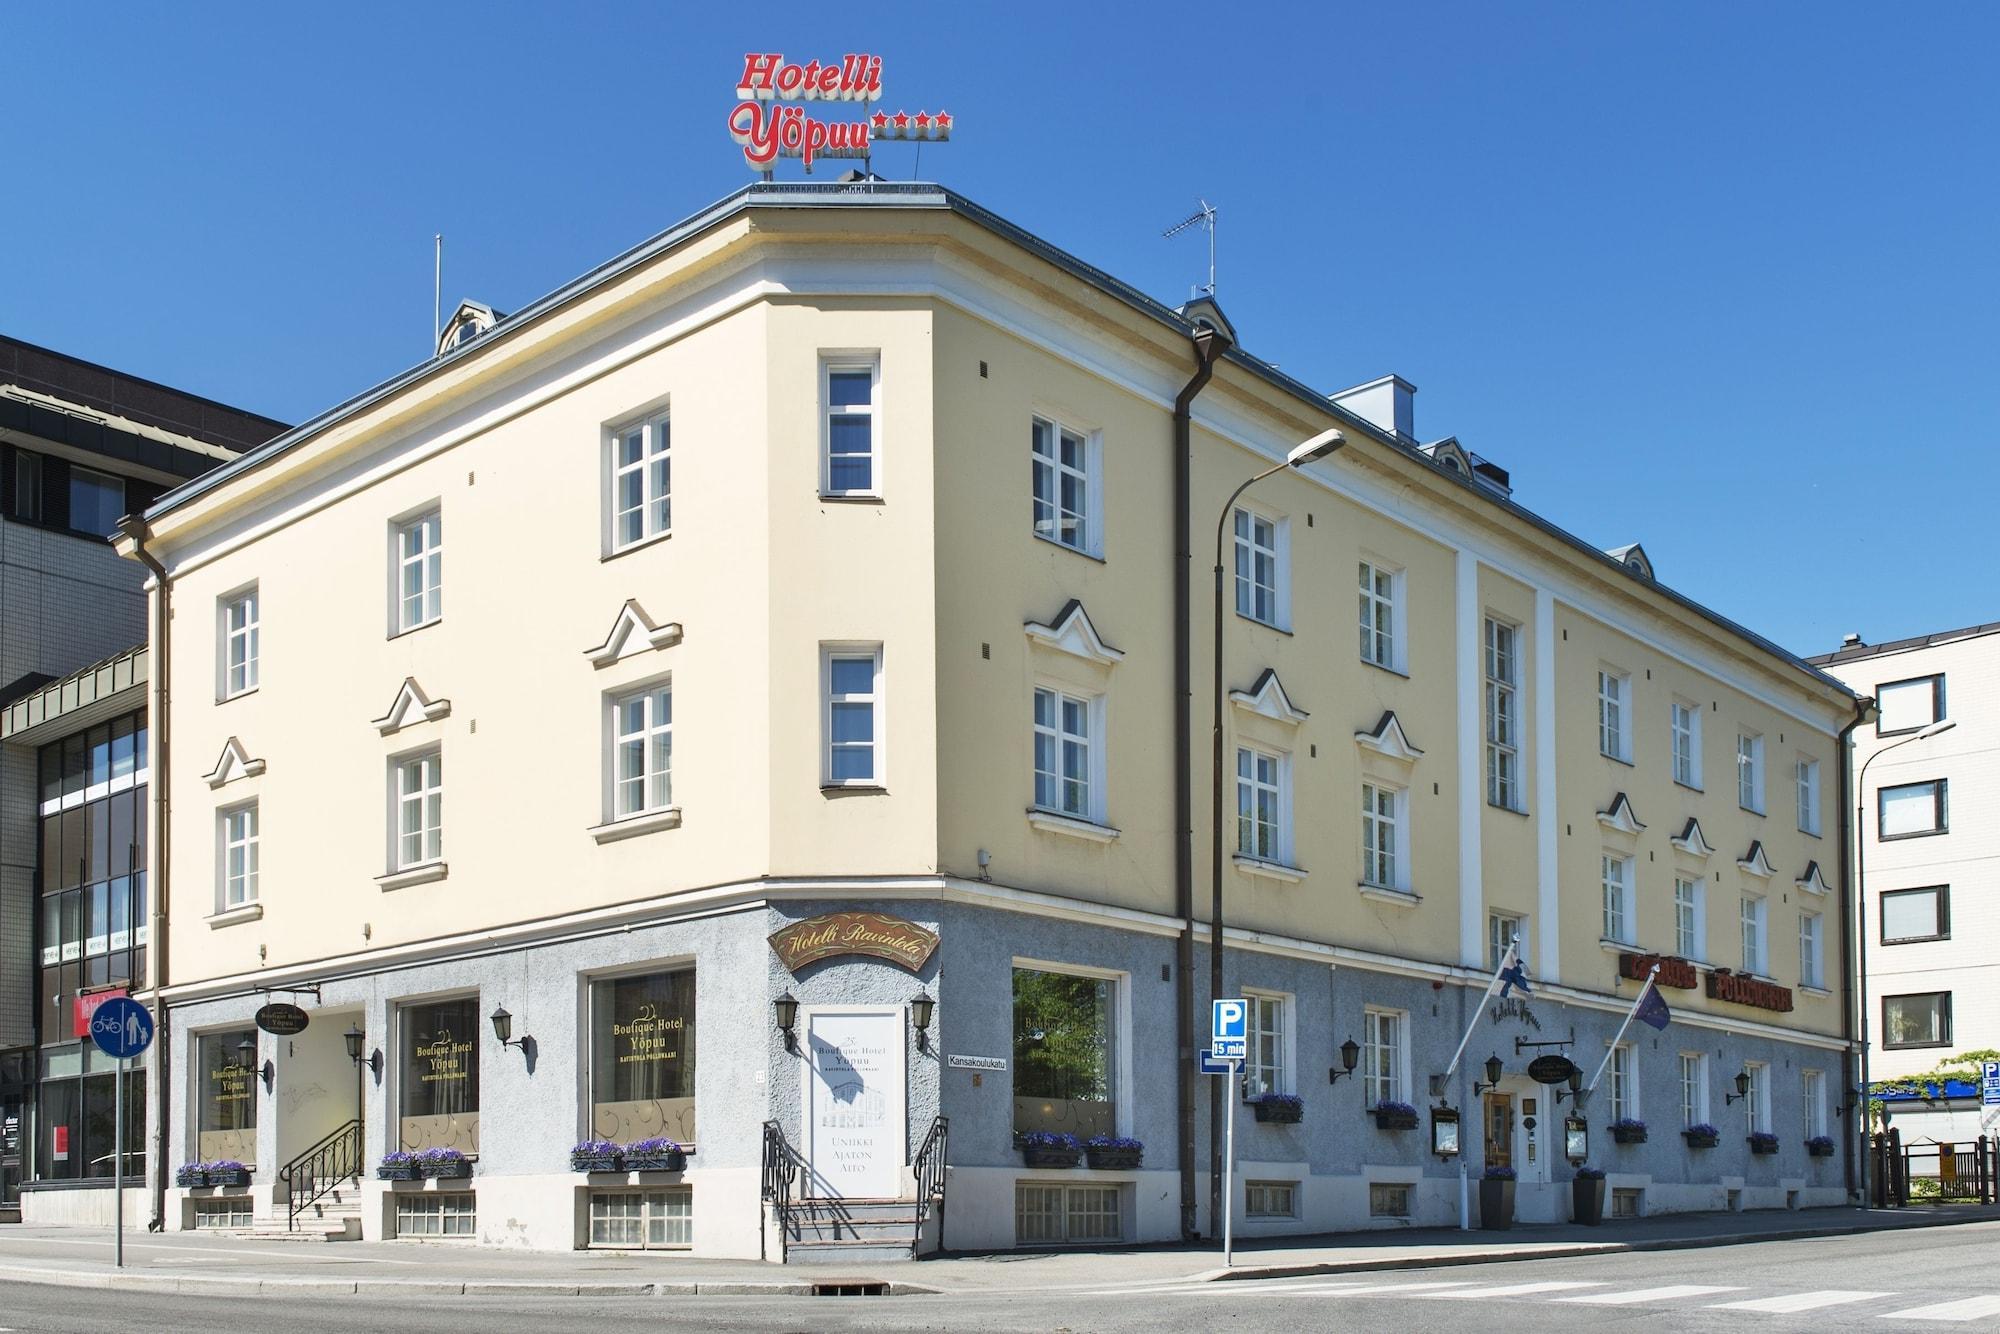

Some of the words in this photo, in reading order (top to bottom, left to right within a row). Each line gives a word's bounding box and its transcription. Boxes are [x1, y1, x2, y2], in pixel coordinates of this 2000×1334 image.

[736, 53, 883, 96] Hotelli
[728, 102, 870, 165] Yöpuu
[789, 924, 839, 954] Hotelli
[842, 922, 922, 953] Ravintola
[613, 1020, 655, 1036] Boutique
[657, 1017, 683, 1031] Hotel
[1220, 1003, 1243, 1035] P
[417, 1044, 449, 1057] Boutique
[451, 1041, 473, 1053] Hotel
[630, 1036, 666, 1053] Yöpuu
[862, 1047, 886, 1055] Hotel
[1214, 1043, 1225, 1055] 15
[1227, 1043, 1245, 1055] min
[430, 1058, 459, 1072] Yöpuu
[950, 1055, 1006, 1069] Kansakoulukatu
[1985, 1063, 1998, 1078] P
[832, 1137, 873, 1146] UNIIKKI
[832, 1151, 873, 1161] AJATON
[840, 1163, 866, 1173] AITO
